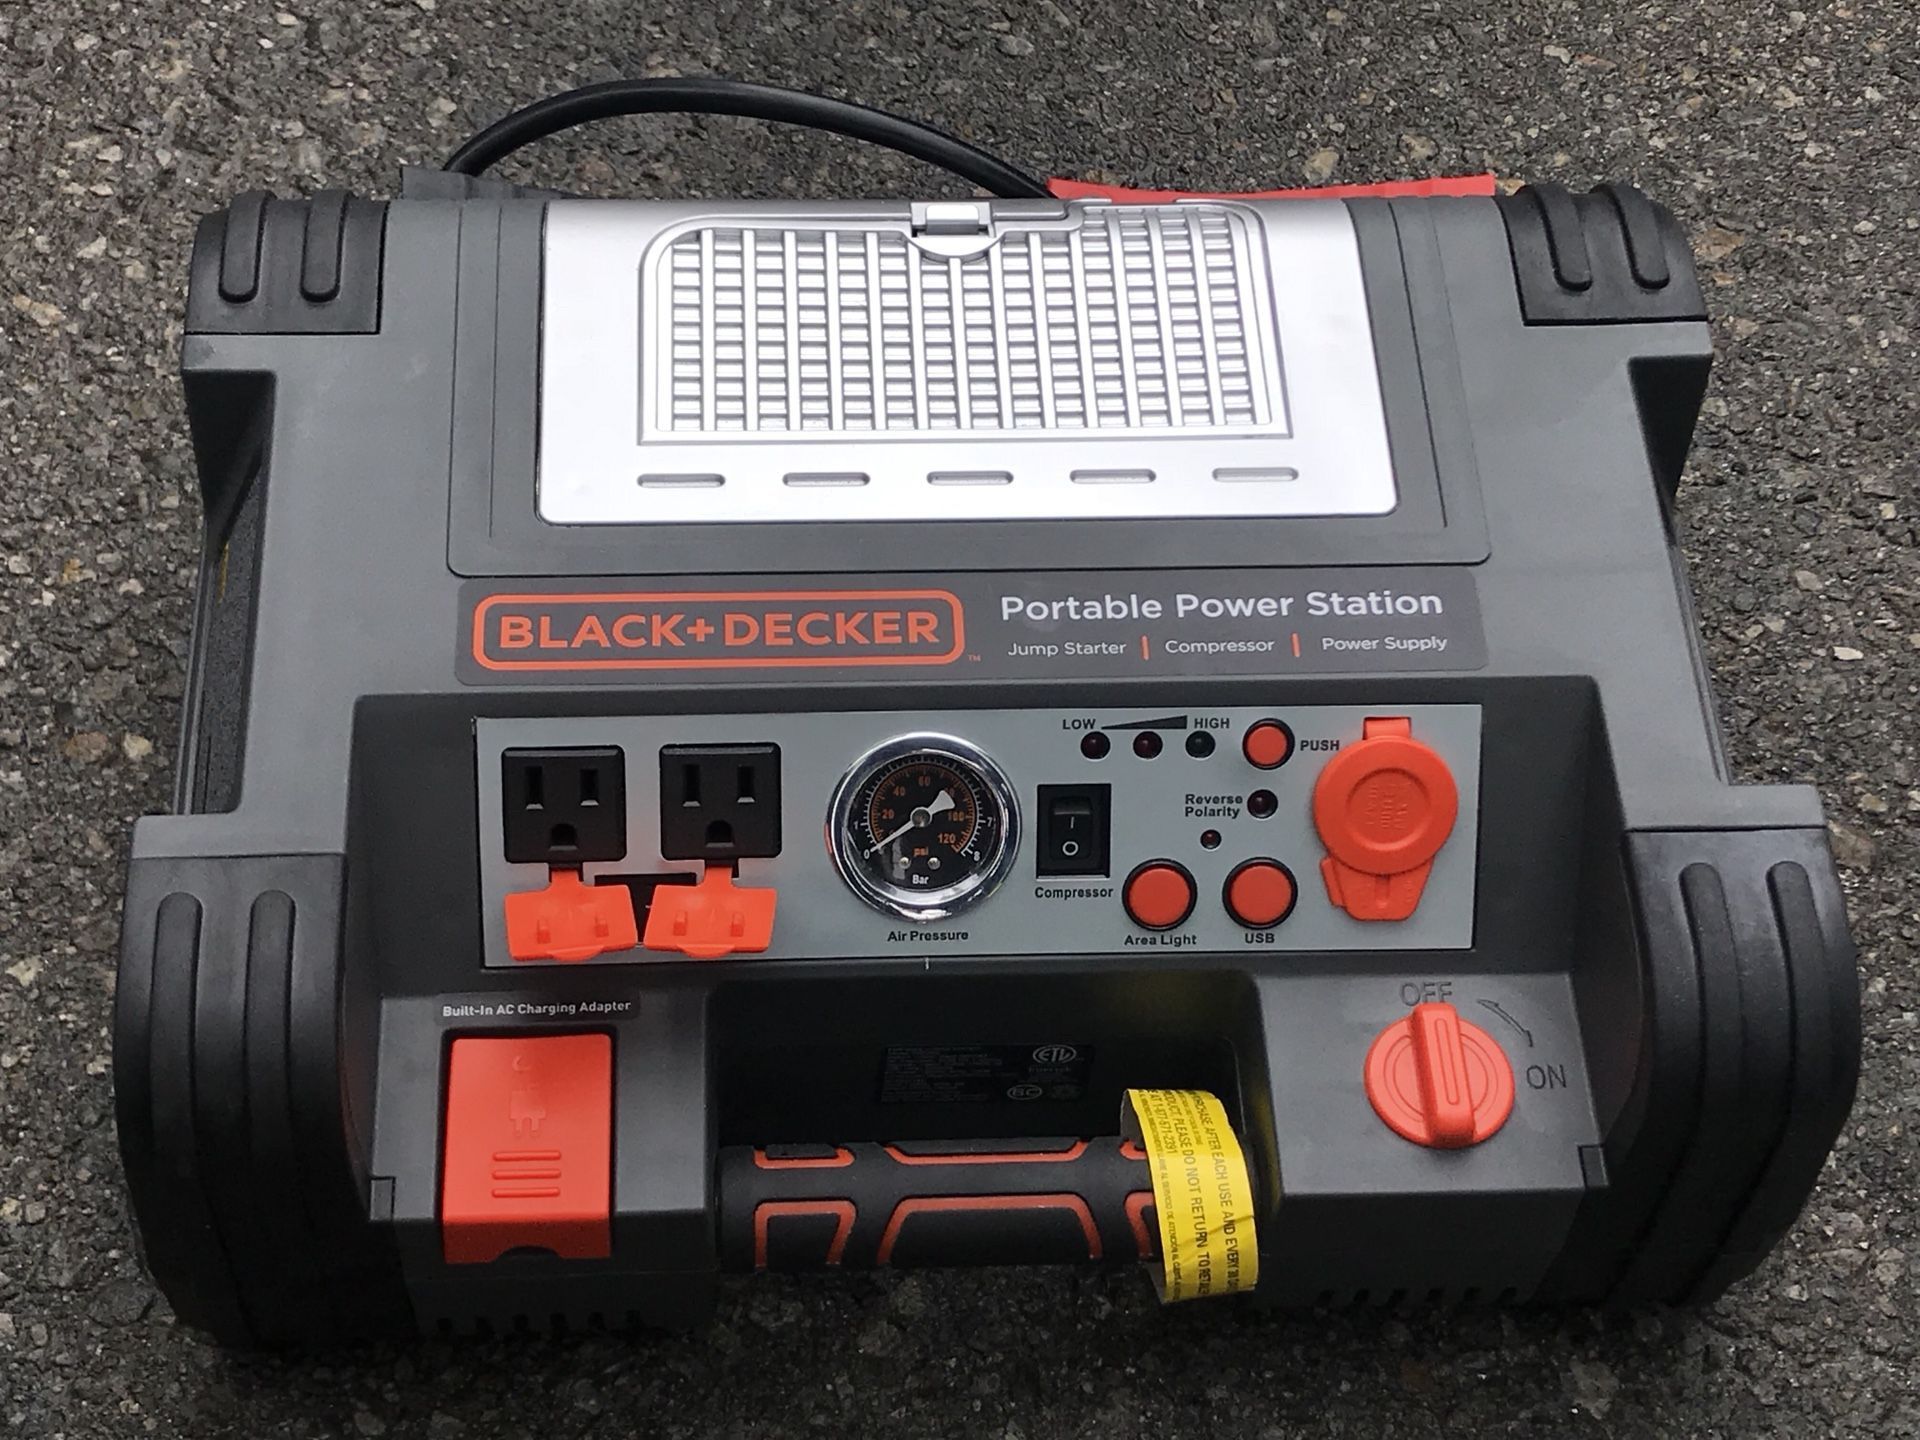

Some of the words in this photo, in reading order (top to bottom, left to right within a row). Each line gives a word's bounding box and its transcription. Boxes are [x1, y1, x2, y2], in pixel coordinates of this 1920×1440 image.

[1001, 594, 1163, 621] Portable
[1176, 593, 1294, 618] Power
[1306, 590, 1444, 616] Station
[499, 610, 940, 648] BLACK+DECKER
[1007, 641, 1059, 657] Jump
[1064, 640, 1127, 655] Starter
[1165, 637, 1275, 655] Compressor
[1321, 637, 1380, 652] Power
[1384, 635, 1448, 653] Supply
[1062, 719, 1096, 730] LOW
[1193, 718, 1231, 729] HIGH
[1300, 740, 1340, 751] PUSH
[893, 788, 906, 797] 40
[1184, 794, 1243, 805] Reverse
[882, 809, 895, 819] 20
[1184, 806, 1241, 819] Polarity
[938, 833, 956, 844] 120
[913, 847, 929, 857] psi
[912, 874, 930, 885] Bar
[1034, 887, 1114, 900] Compressor
[887, 930, 907, 942] Air
[910, 930, 969, 941] Pressure
[1124, 935, 1157, 946] Area
[1160, 934, 1197, 947] Light
[1244, 933, 1275, 944] USB
[1401, 982, 1453, 1007] OFF
[443, 1005, 494, 1017] Built-In
[496, 1004, 515, 1015] AC
[517, 1002, 576, 1016] Charging
[579, 1001, 632, 1014] Adapter
[1526, 1064, 1567, 1089] ON
[1173, 1118, 1192, 1148] PLEASE
[1204, 1127, 1221, 1151] AFTER
[1182, 1149, 1196, 1165] DO
[1212, 1152, 1229, 1180] EACH
[1185, 1168, 1202, 1194] NOT
[1218, 1183, 1233, 1207] USE
[1191, 1197, 1208, 1248] RETURN
[1221, 1211, 1236, 1235] AND
[1197, 1251, 1211, 1267] TO
[1225, 1238, 1240, 1268] EVERY
